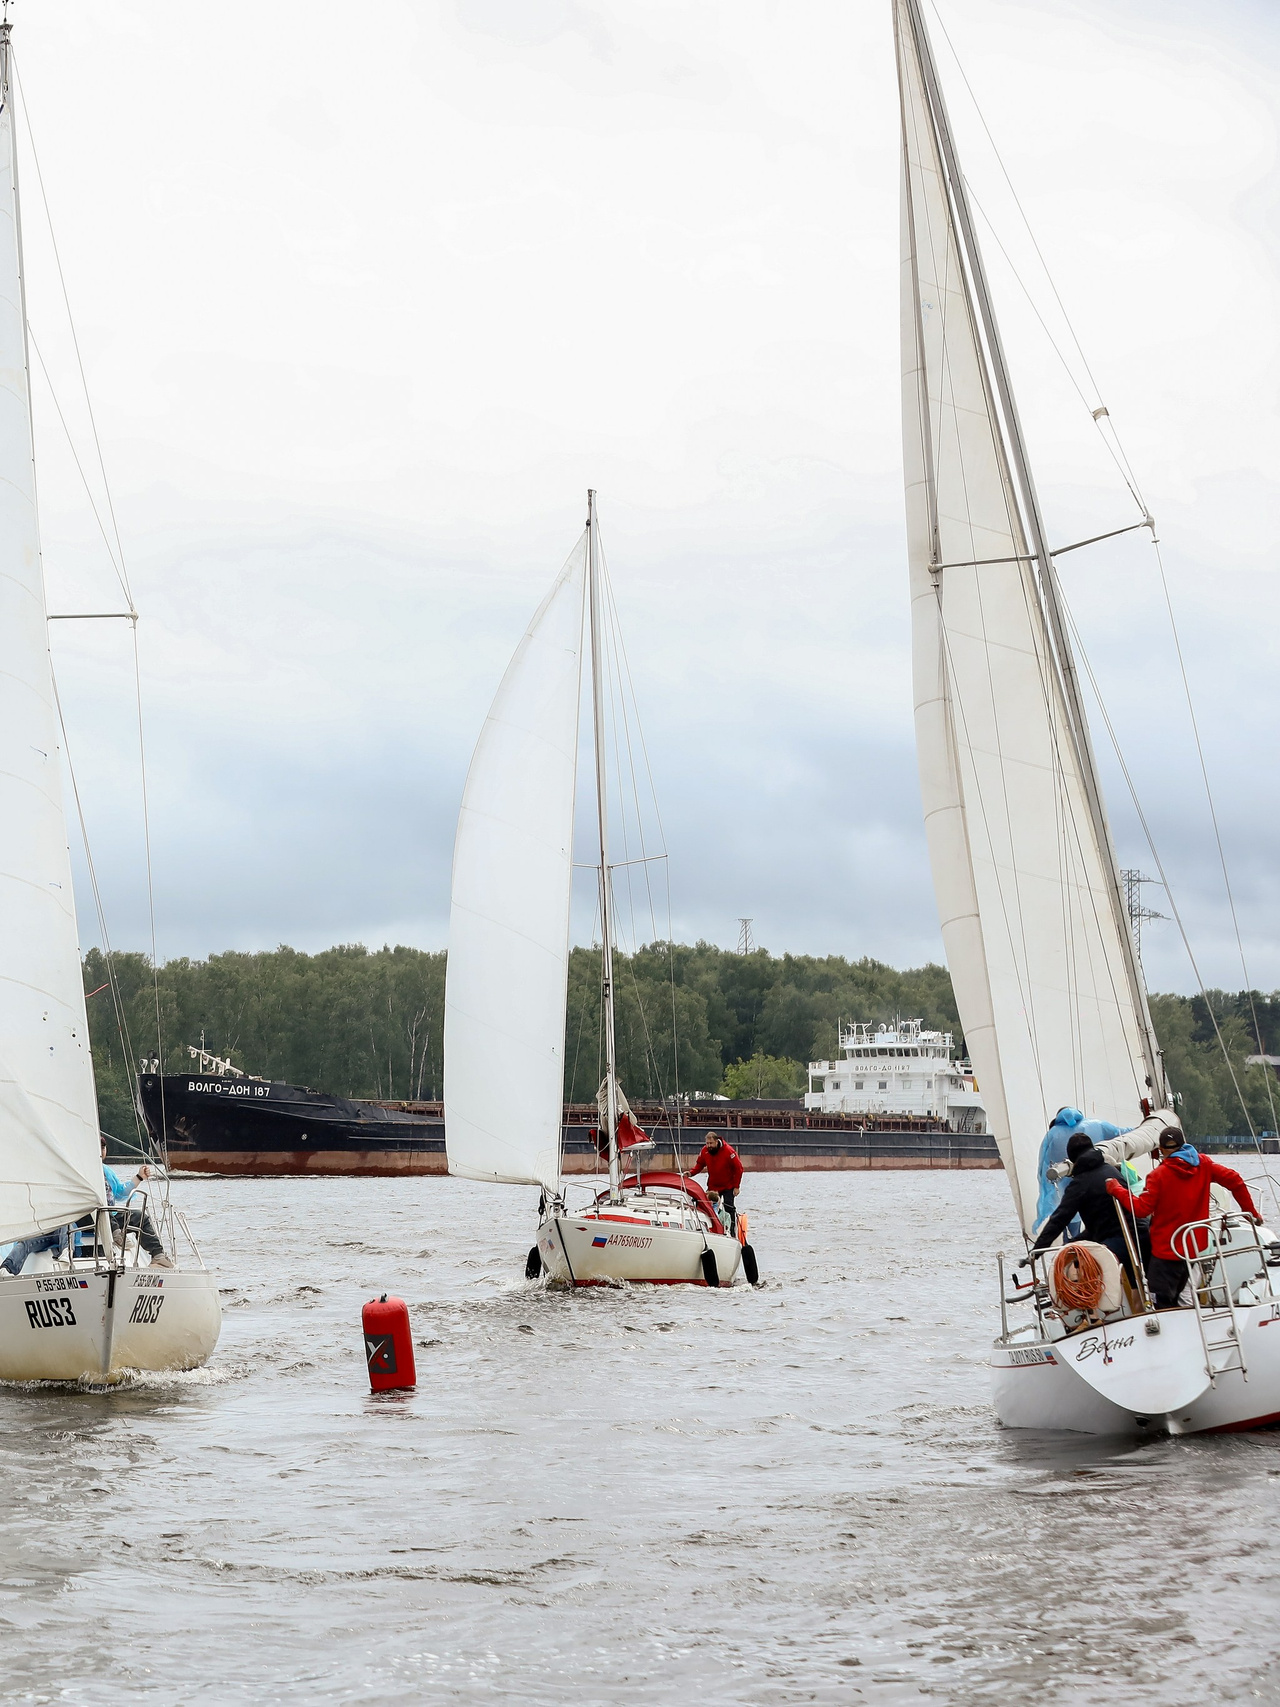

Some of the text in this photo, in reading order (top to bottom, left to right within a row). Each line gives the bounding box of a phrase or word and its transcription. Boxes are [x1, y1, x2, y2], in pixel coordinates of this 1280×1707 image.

[188, 1081, 270, 1097] ВОЛГО-ДОН 187
[43, 1278, 66, 1292] 55-38
[24, 1297, 77, 1329] RUS3
[129, 1294, 165, 1324] RUS3
